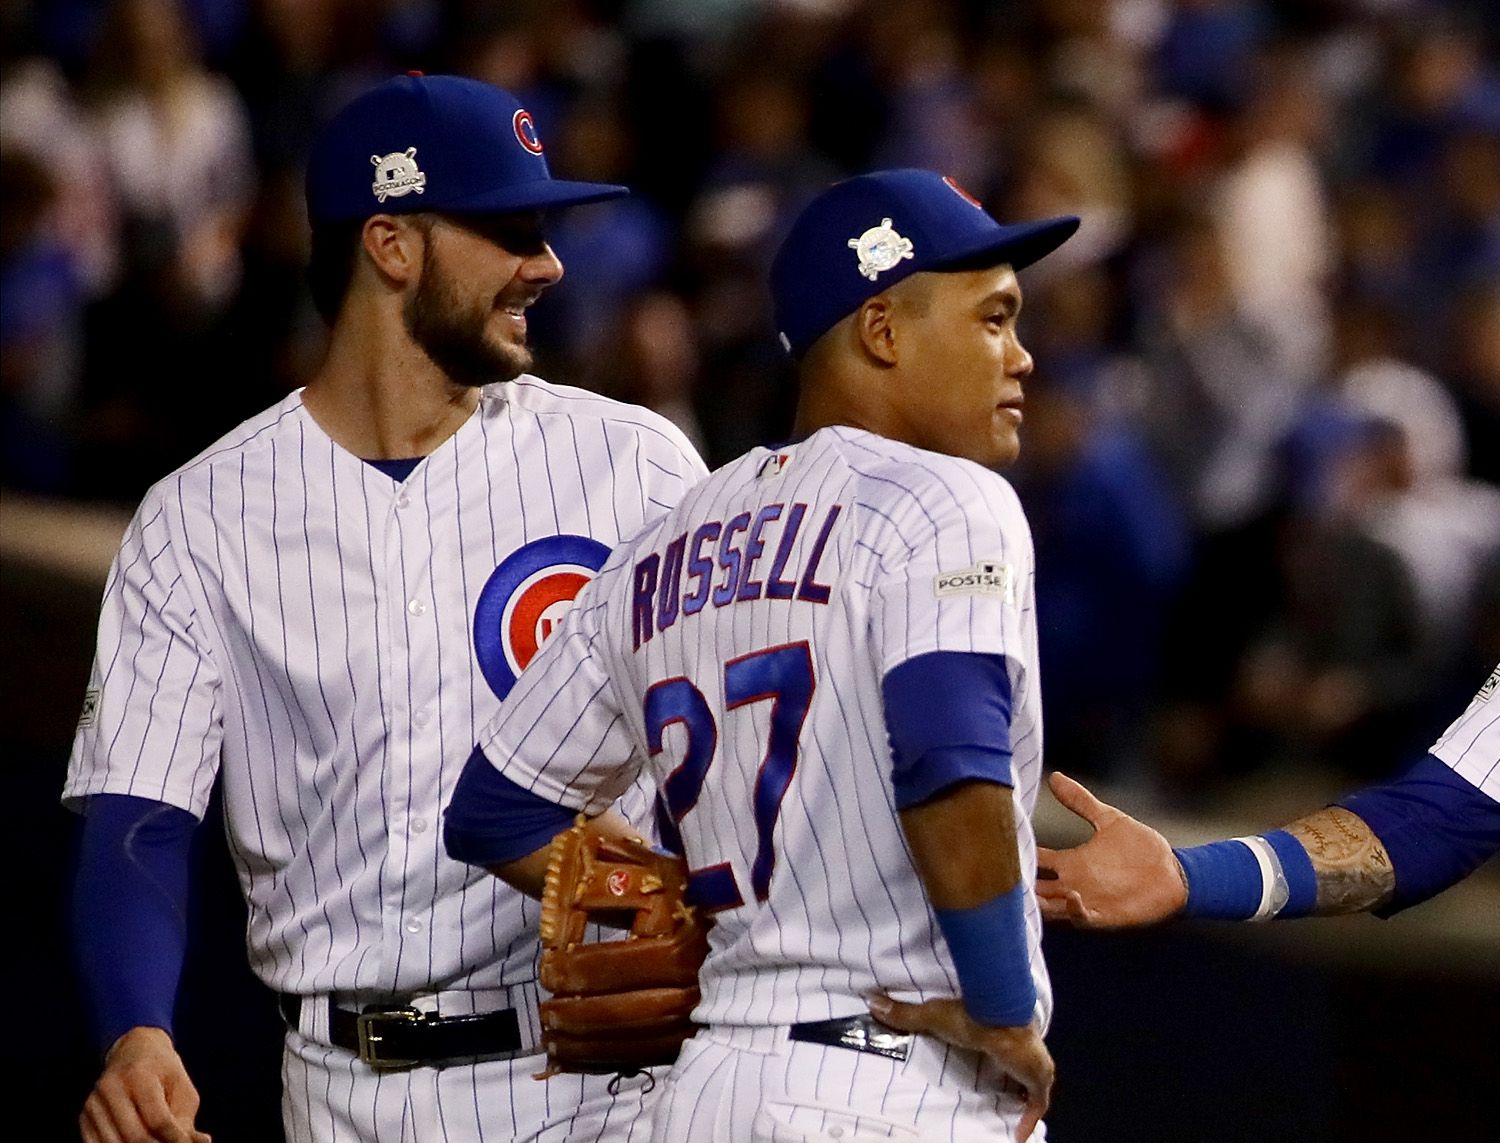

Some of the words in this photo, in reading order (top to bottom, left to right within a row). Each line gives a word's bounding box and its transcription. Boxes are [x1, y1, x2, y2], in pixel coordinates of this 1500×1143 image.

[632, 502, 841, 654] RUSSELL
[938, 574, 1001, 590] POSTSE
[643, 640, 816, 912] 27
